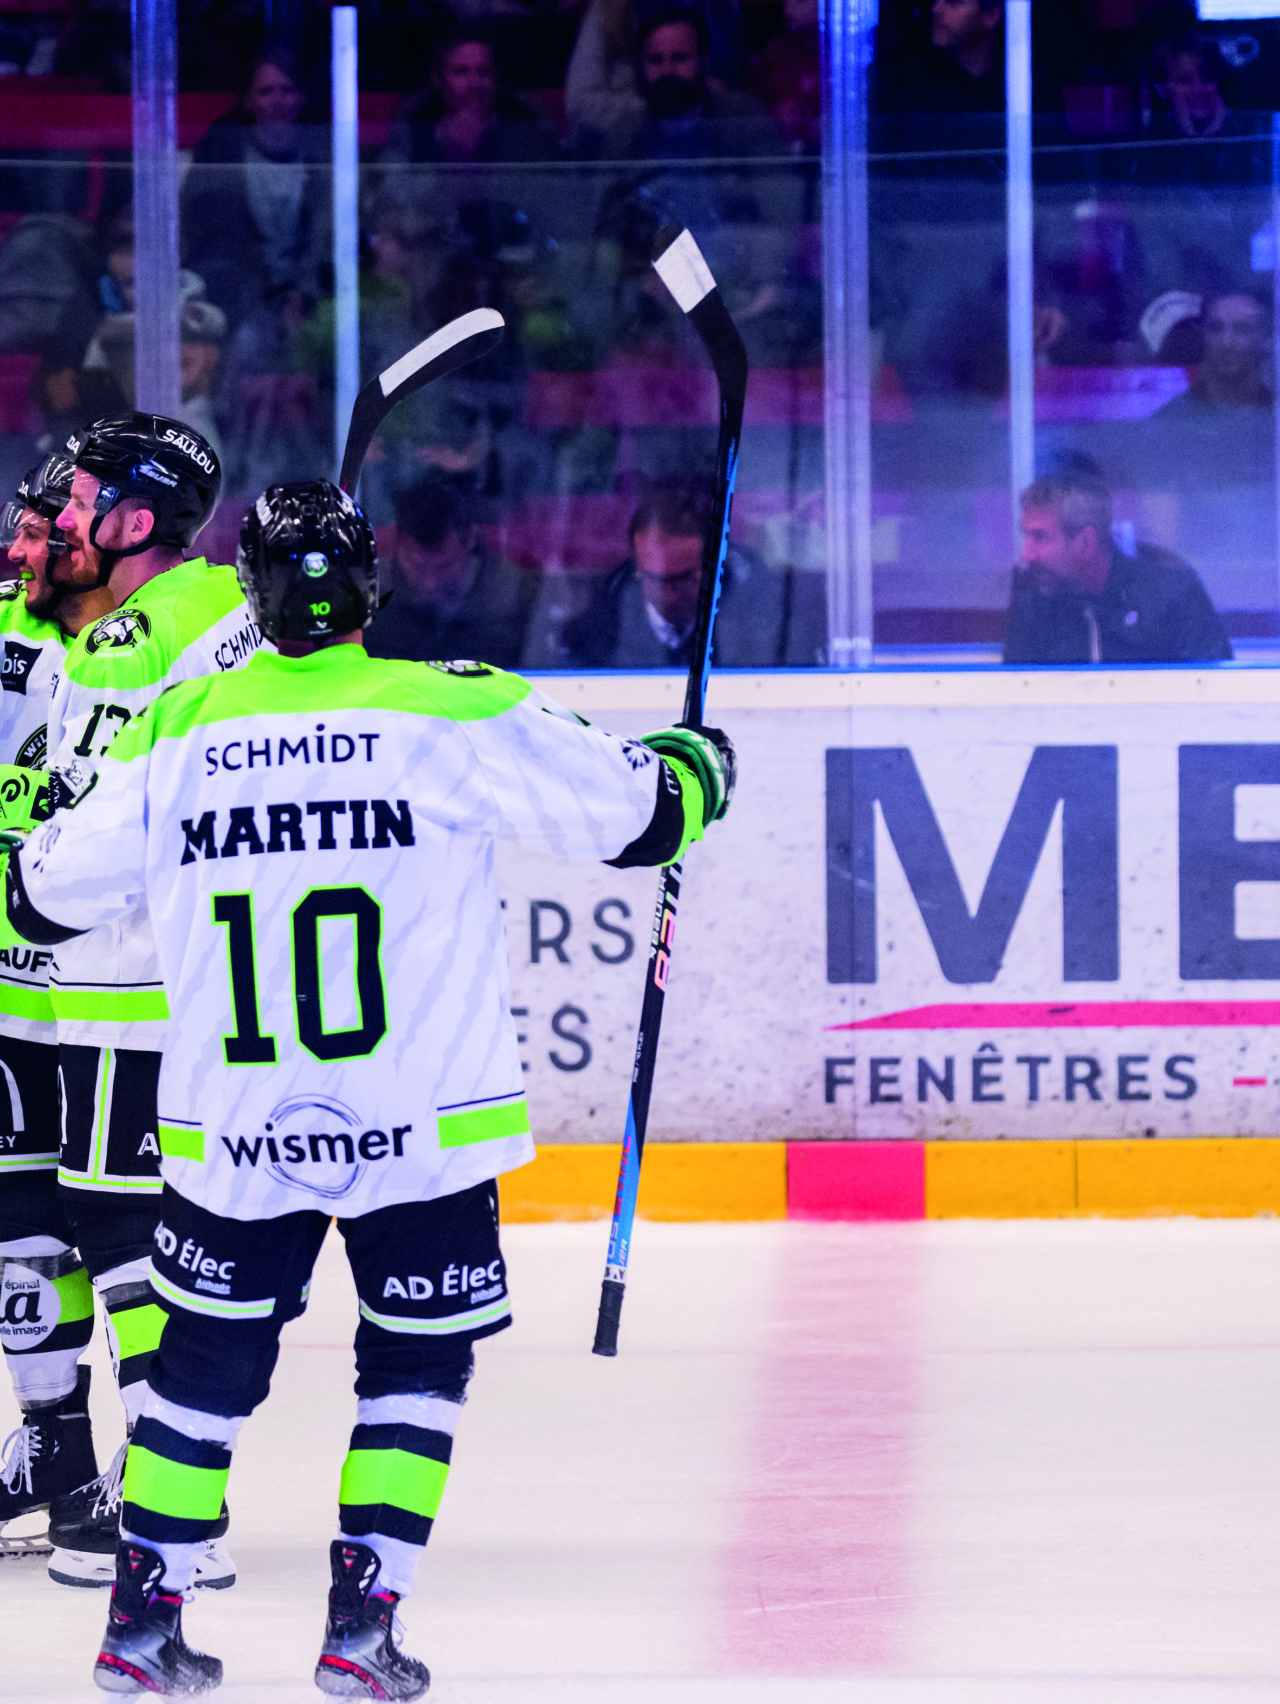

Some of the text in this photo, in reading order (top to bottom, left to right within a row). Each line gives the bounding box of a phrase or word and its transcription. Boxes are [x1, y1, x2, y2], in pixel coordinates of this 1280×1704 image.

[163, 428, 216, 475] SAULOU
[309, 601, 331, 615] 10
[1, 653, 28, 675] bis
[180, 799, 416, 866] MARTIN
[500, 896, 635, 966] RS
[210, 882, 390, 1067] 10
[824, 1042, 1200, 1103] FENÊTRES
[221, 1122, 413, 1168] wismer
[177, 1238, 236, 1280] Élec
[382, 1259, 501, 1300] AD Élec
[5, 1279, 41, 1291] épinal
[12, 1325, 49, 1336] image
